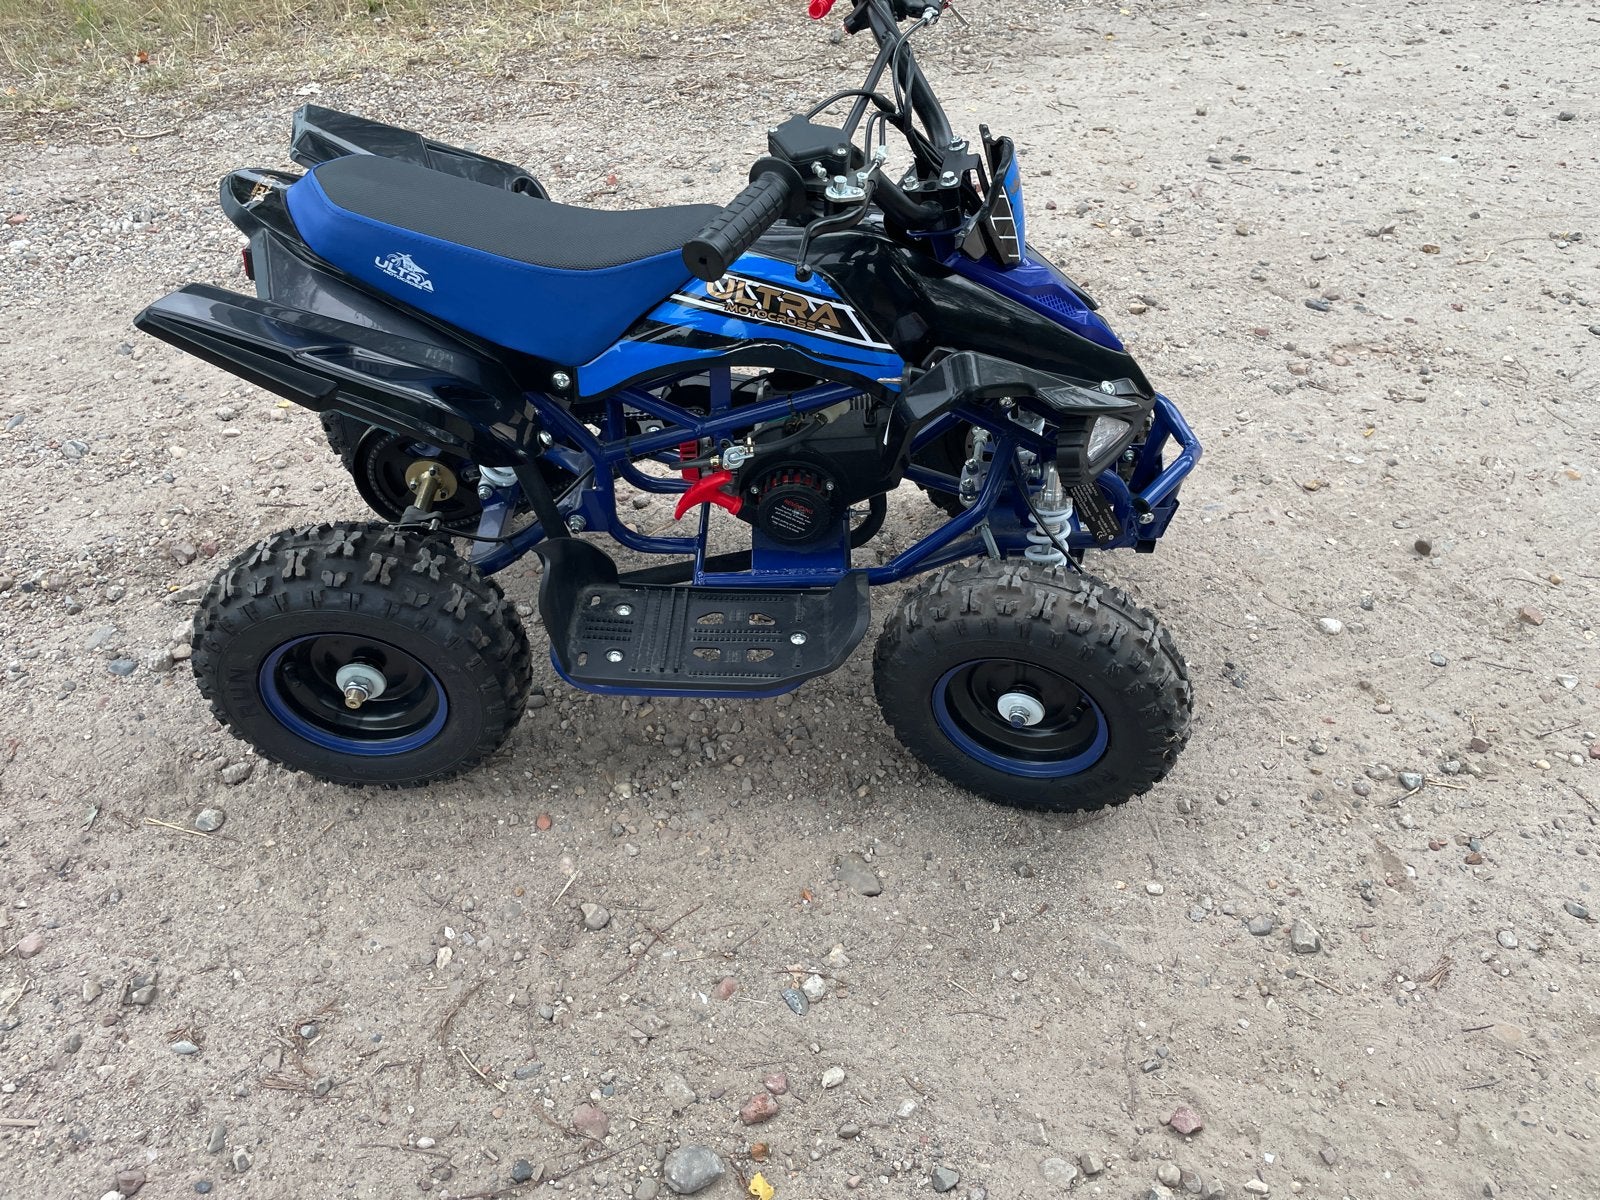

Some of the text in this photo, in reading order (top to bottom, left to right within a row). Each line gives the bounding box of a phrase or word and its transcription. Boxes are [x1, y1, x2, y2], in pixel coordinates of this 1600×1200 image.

[374, 255, 435, 292] ULTRA
[382, 269, 423, 290] MOTOCROSS
[706, 277, 842, 329] ULTRA
[724, 302, 817, 332] MOTOCROSS
